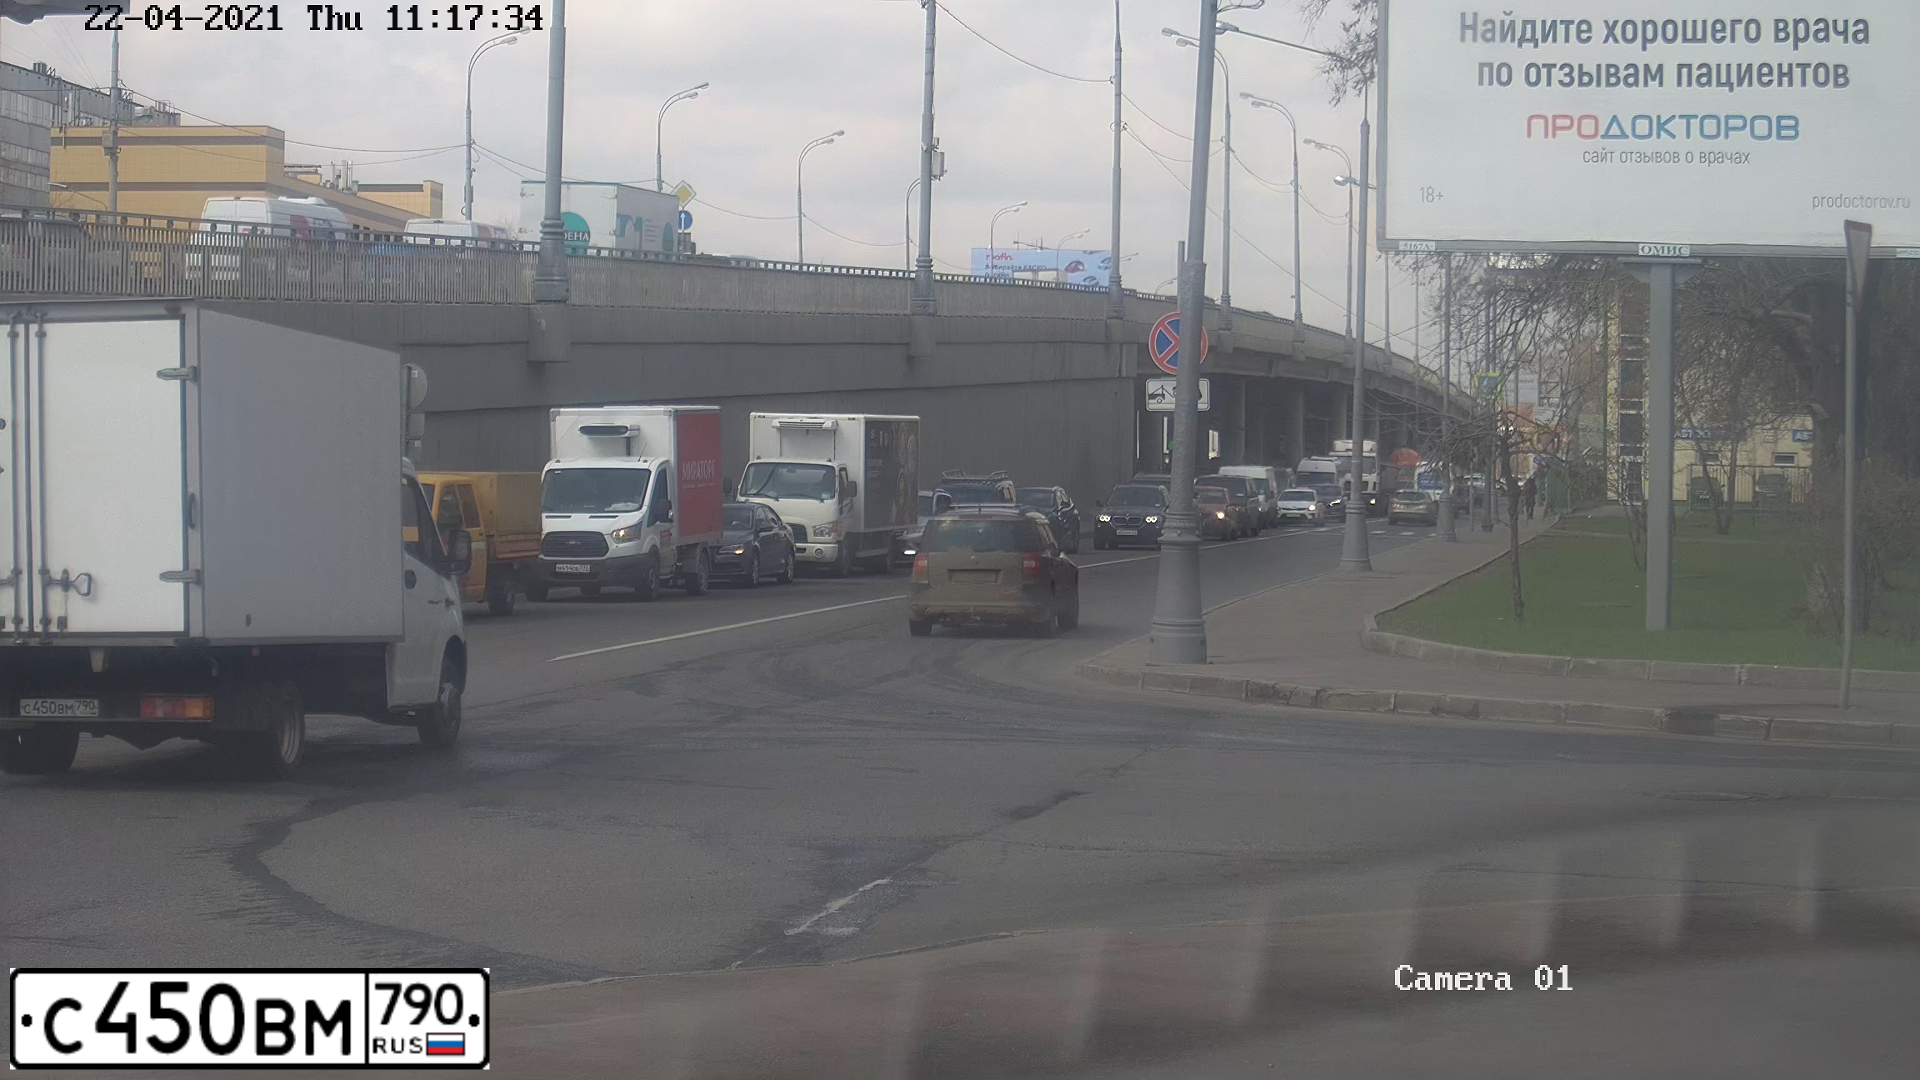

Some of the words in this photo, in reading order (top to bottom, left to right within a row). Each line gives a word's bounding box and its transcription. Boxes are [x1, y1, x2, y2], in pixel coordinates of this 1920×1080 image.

[1458, 10, 1593, 49] Найдите
[1602, 16, 1763, 51] хорошего
[1772, 16, 1871, 52] врача
[1477, 61, 1514, 88] по
[1523, 61, 1664, 89] отзывам
[1675, 62, 1851, 93] пациентов
[1526, 114, 1801, 142] ПРОДОКТОРОВ
[1582, 147, 1615, 165] сайт
[1619, 150, 1681, 165] отзывов
[1684, 151, 1694, 165] о
[1698, 150, 1751, 168] врачах
[1419, 186, 1445, 204] 18+
[1812, 193, 1911, 211] prodoctorov.ru
[1640, 244, 1689, 256] ОМИС
[682, 459, 716, 481] МИРАТОРГ
[23, 700, 74, 714] С450ВМ
[75, 700, 96, 711] 790
